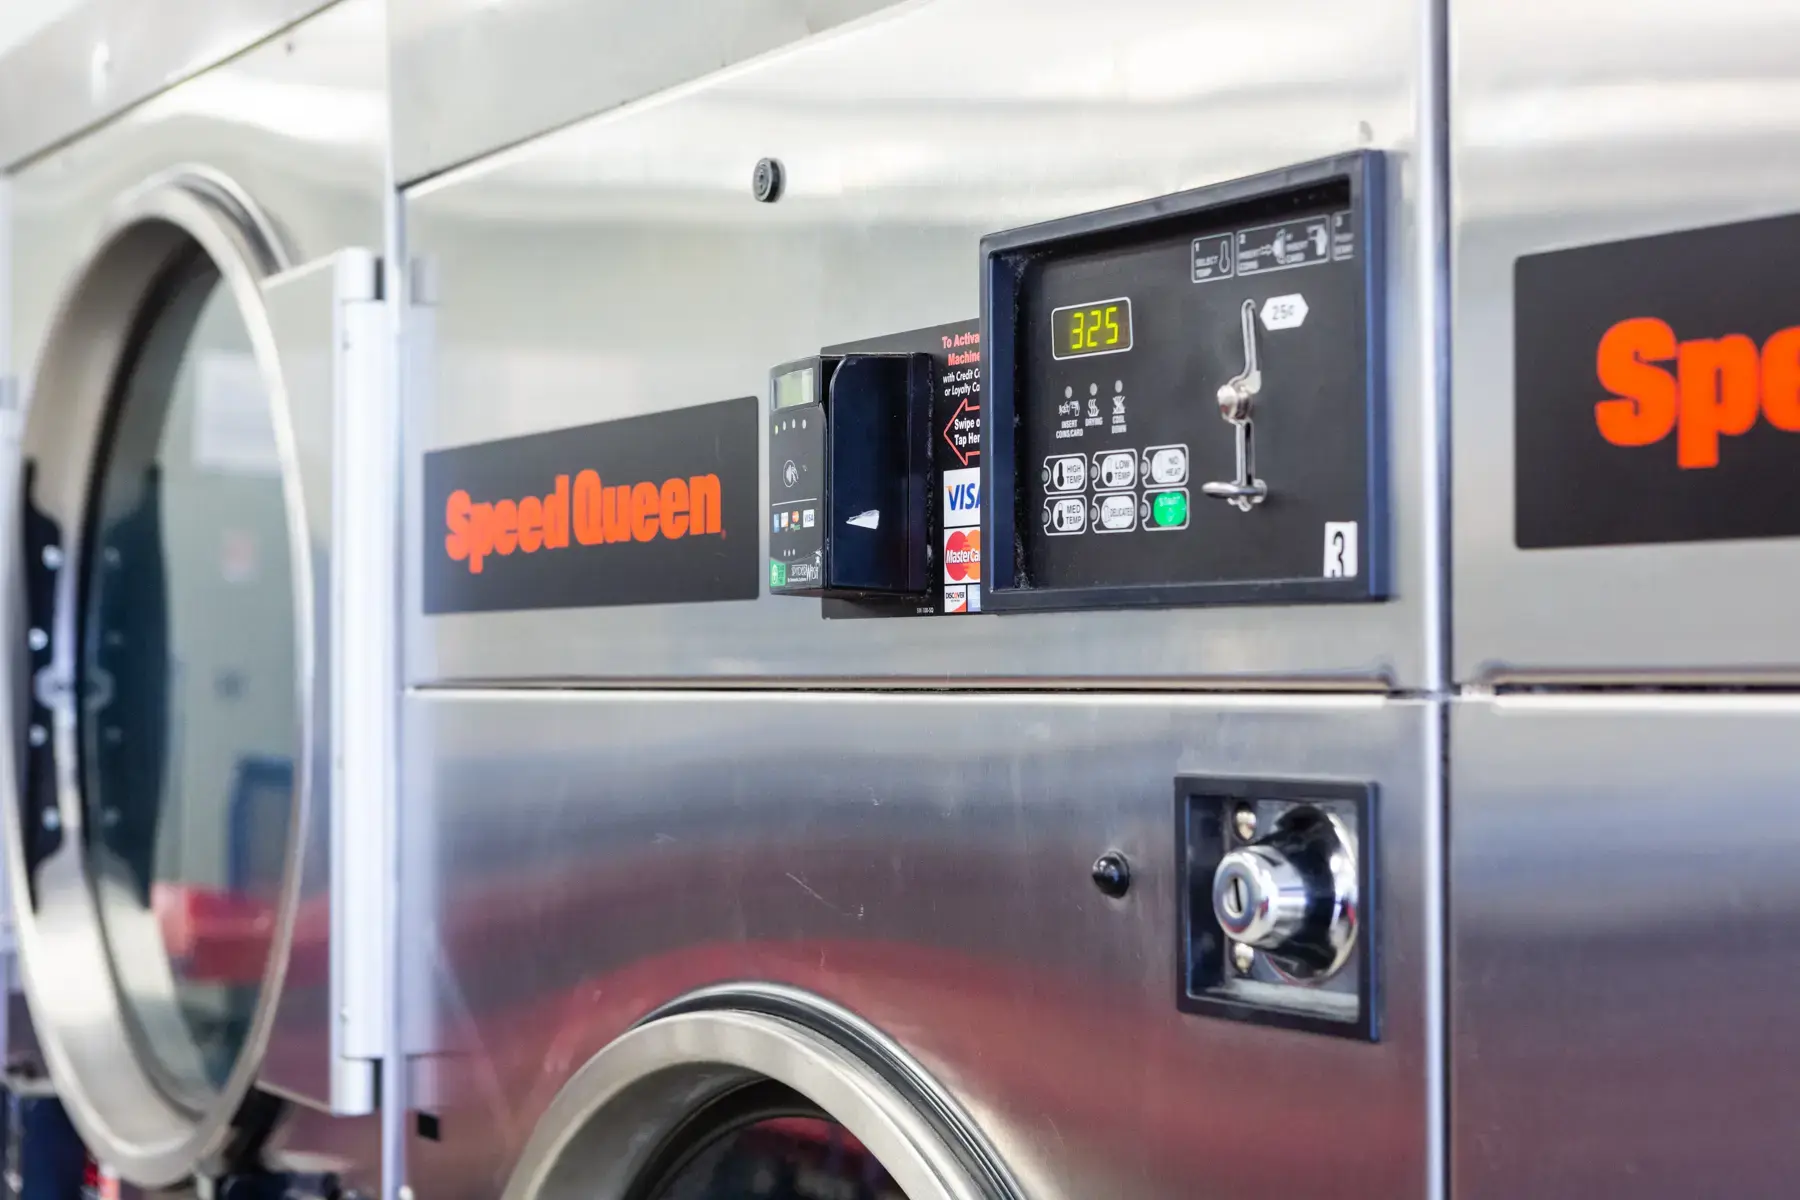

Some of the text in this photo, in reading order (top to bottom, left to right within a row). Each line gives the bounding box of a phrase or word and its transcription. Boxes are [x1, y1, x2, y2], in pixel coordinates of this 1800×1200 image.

[1071, 306, 1119, 350] 325
[942, 332, 980, 349] To Activa
[943, 372, 955, 383] with
[956, 368, 973, 381] Credit
[944, 388, 951, 396] or
[951, 383, 971, 397] Loyalty
[954, 417, 975, 431] Swipe
[1061, 419, 1078, 429] INSERT
[954, 432, 980, 447] Tap Her
[1066, 464, 1082, 473] HIGH
[1114, 459, 1130, 470] LOW
[1066, 475, 1083, 484] TEMP
[1114, 471, 1131, 480] TEMP
[1066, 504, 1081, 514] MED
[445, 468, 722, 574] Speed Queen
[1065, 516, 1082, 525] TEMP
[946, 548, 980, 563] MasterCa
[945, 591, 965, 600] DISCOVER
